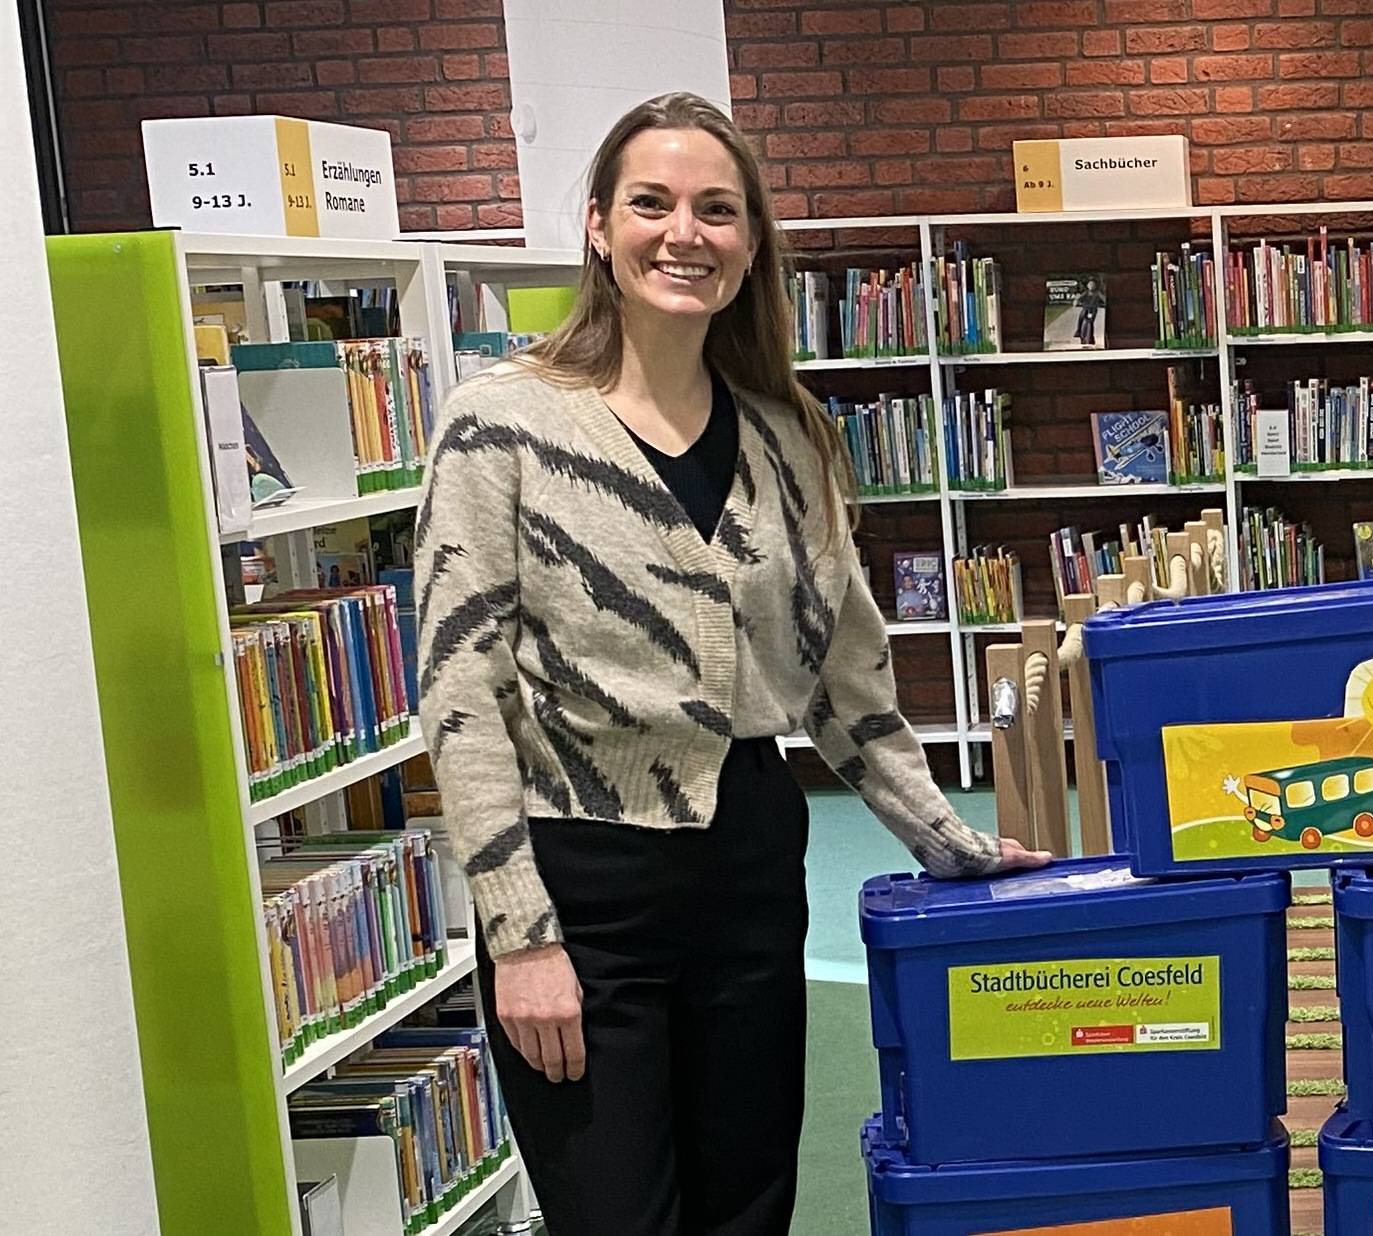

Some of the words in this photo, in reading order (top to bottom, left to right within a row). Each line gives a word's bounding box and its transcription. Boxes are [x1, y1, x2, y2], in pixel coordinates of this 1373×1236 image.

[188, 162, 216, 176] 5.1
[284, 162, 296, 177] 5.1
[322, 160, 382, 188] Erzählungen
[1022, 164, 1029, 172] 6
[1074, 157, 1158, 170] Sachbücher
[192, 195, 232, 209] 9-13
[238, 194, 252, 208] J.
[325, 191, 366, 213] Romane
[1102, 413, 1135, 440] FLIGHT
[1114, 413, 1151, 442] SCHOOL
[970, 966, 1110, 994] Stadtbücherei
[1117, 963, 1203, 987] Coesfeld
[1005, 996, 1072, 1012] entdecke
[1076, 998, 1112, 1009] neue
[1116, 990, 1171, 1007] Welten!
